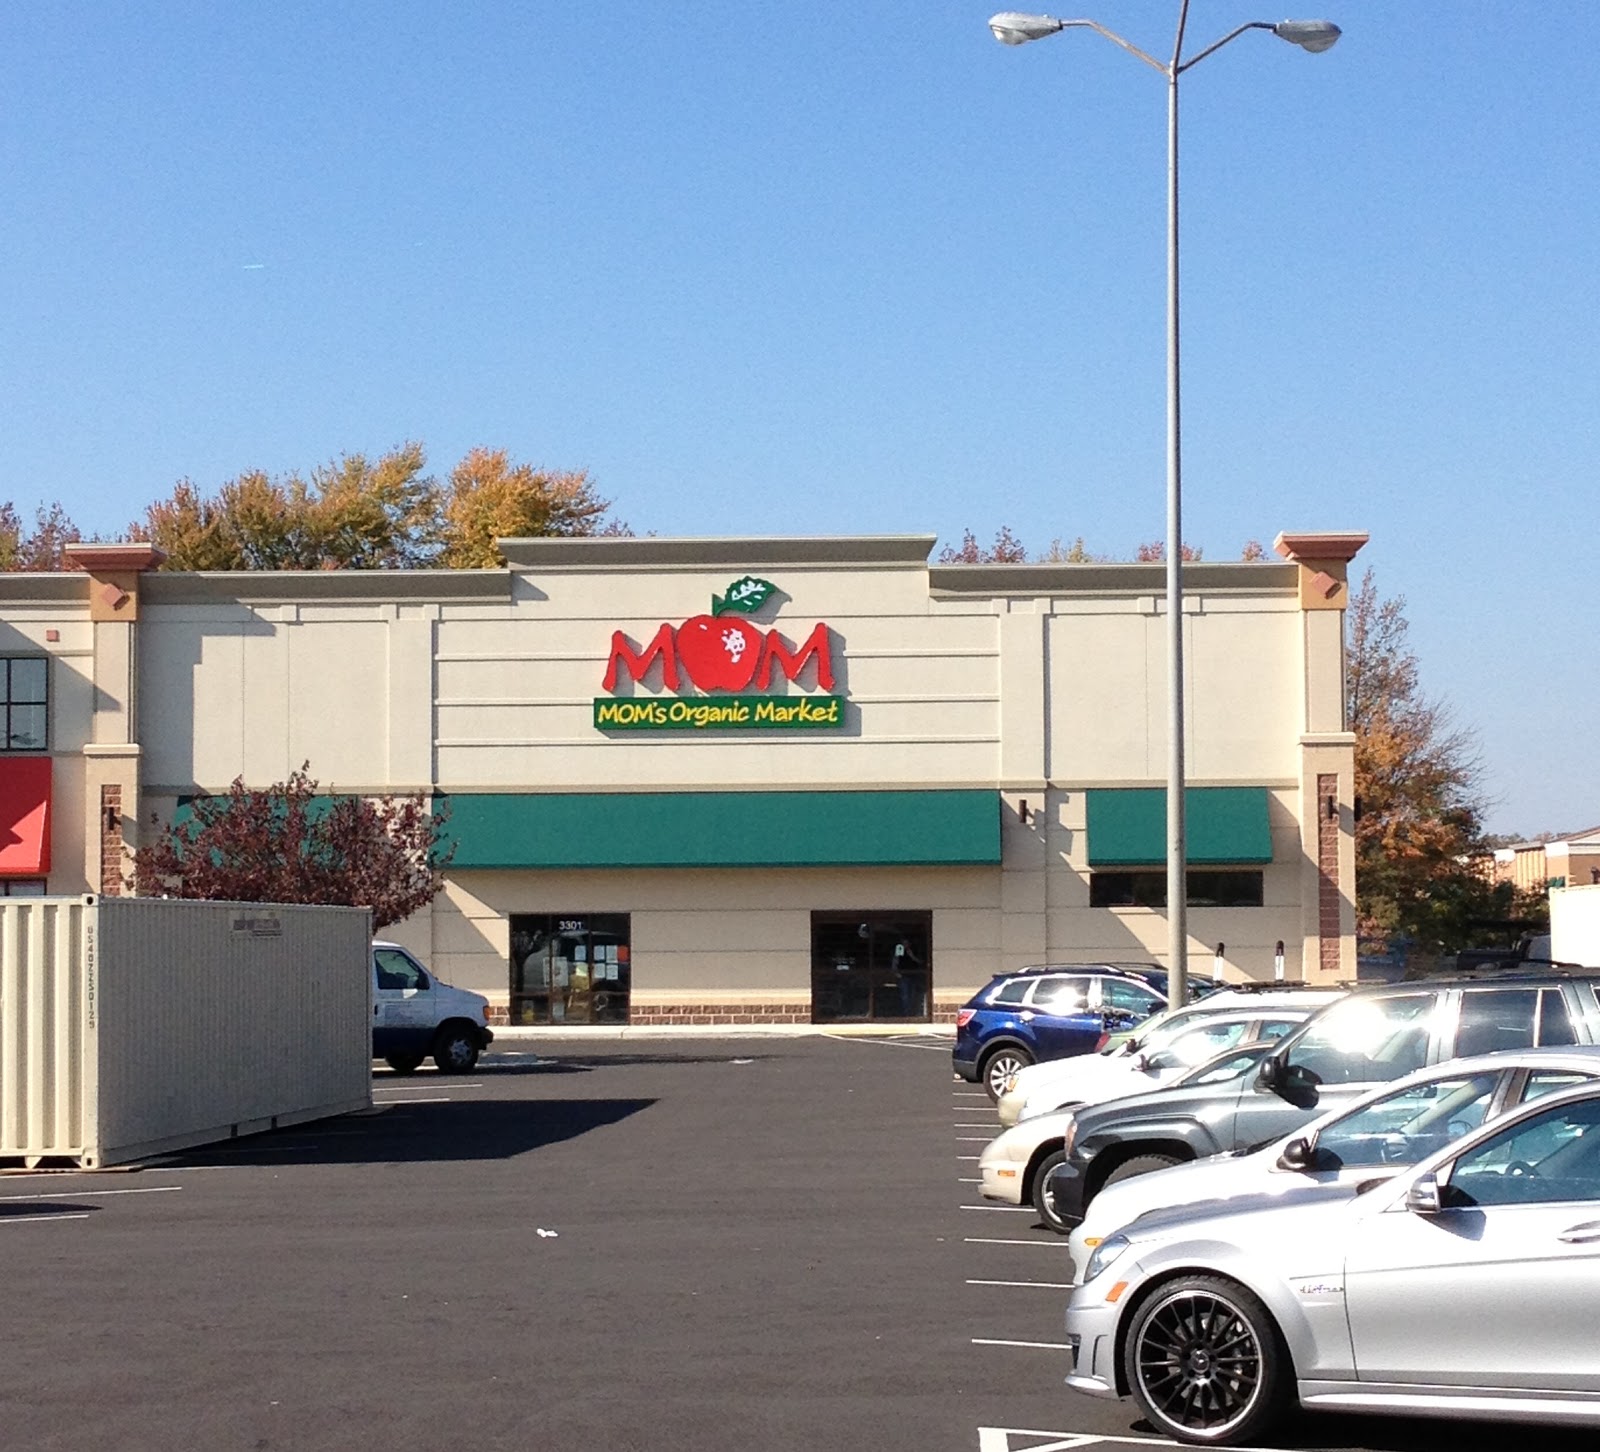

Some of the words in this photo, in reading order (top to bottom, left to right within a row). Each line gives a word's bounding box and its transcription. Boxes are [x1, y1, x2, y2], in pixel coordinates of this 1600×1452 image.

[598, 702, 667, 724] MOM's
[669, 699, 750, 726] Organic
[755, 698, 838, 722] Market
[558, 920, 582, 930] 3301
